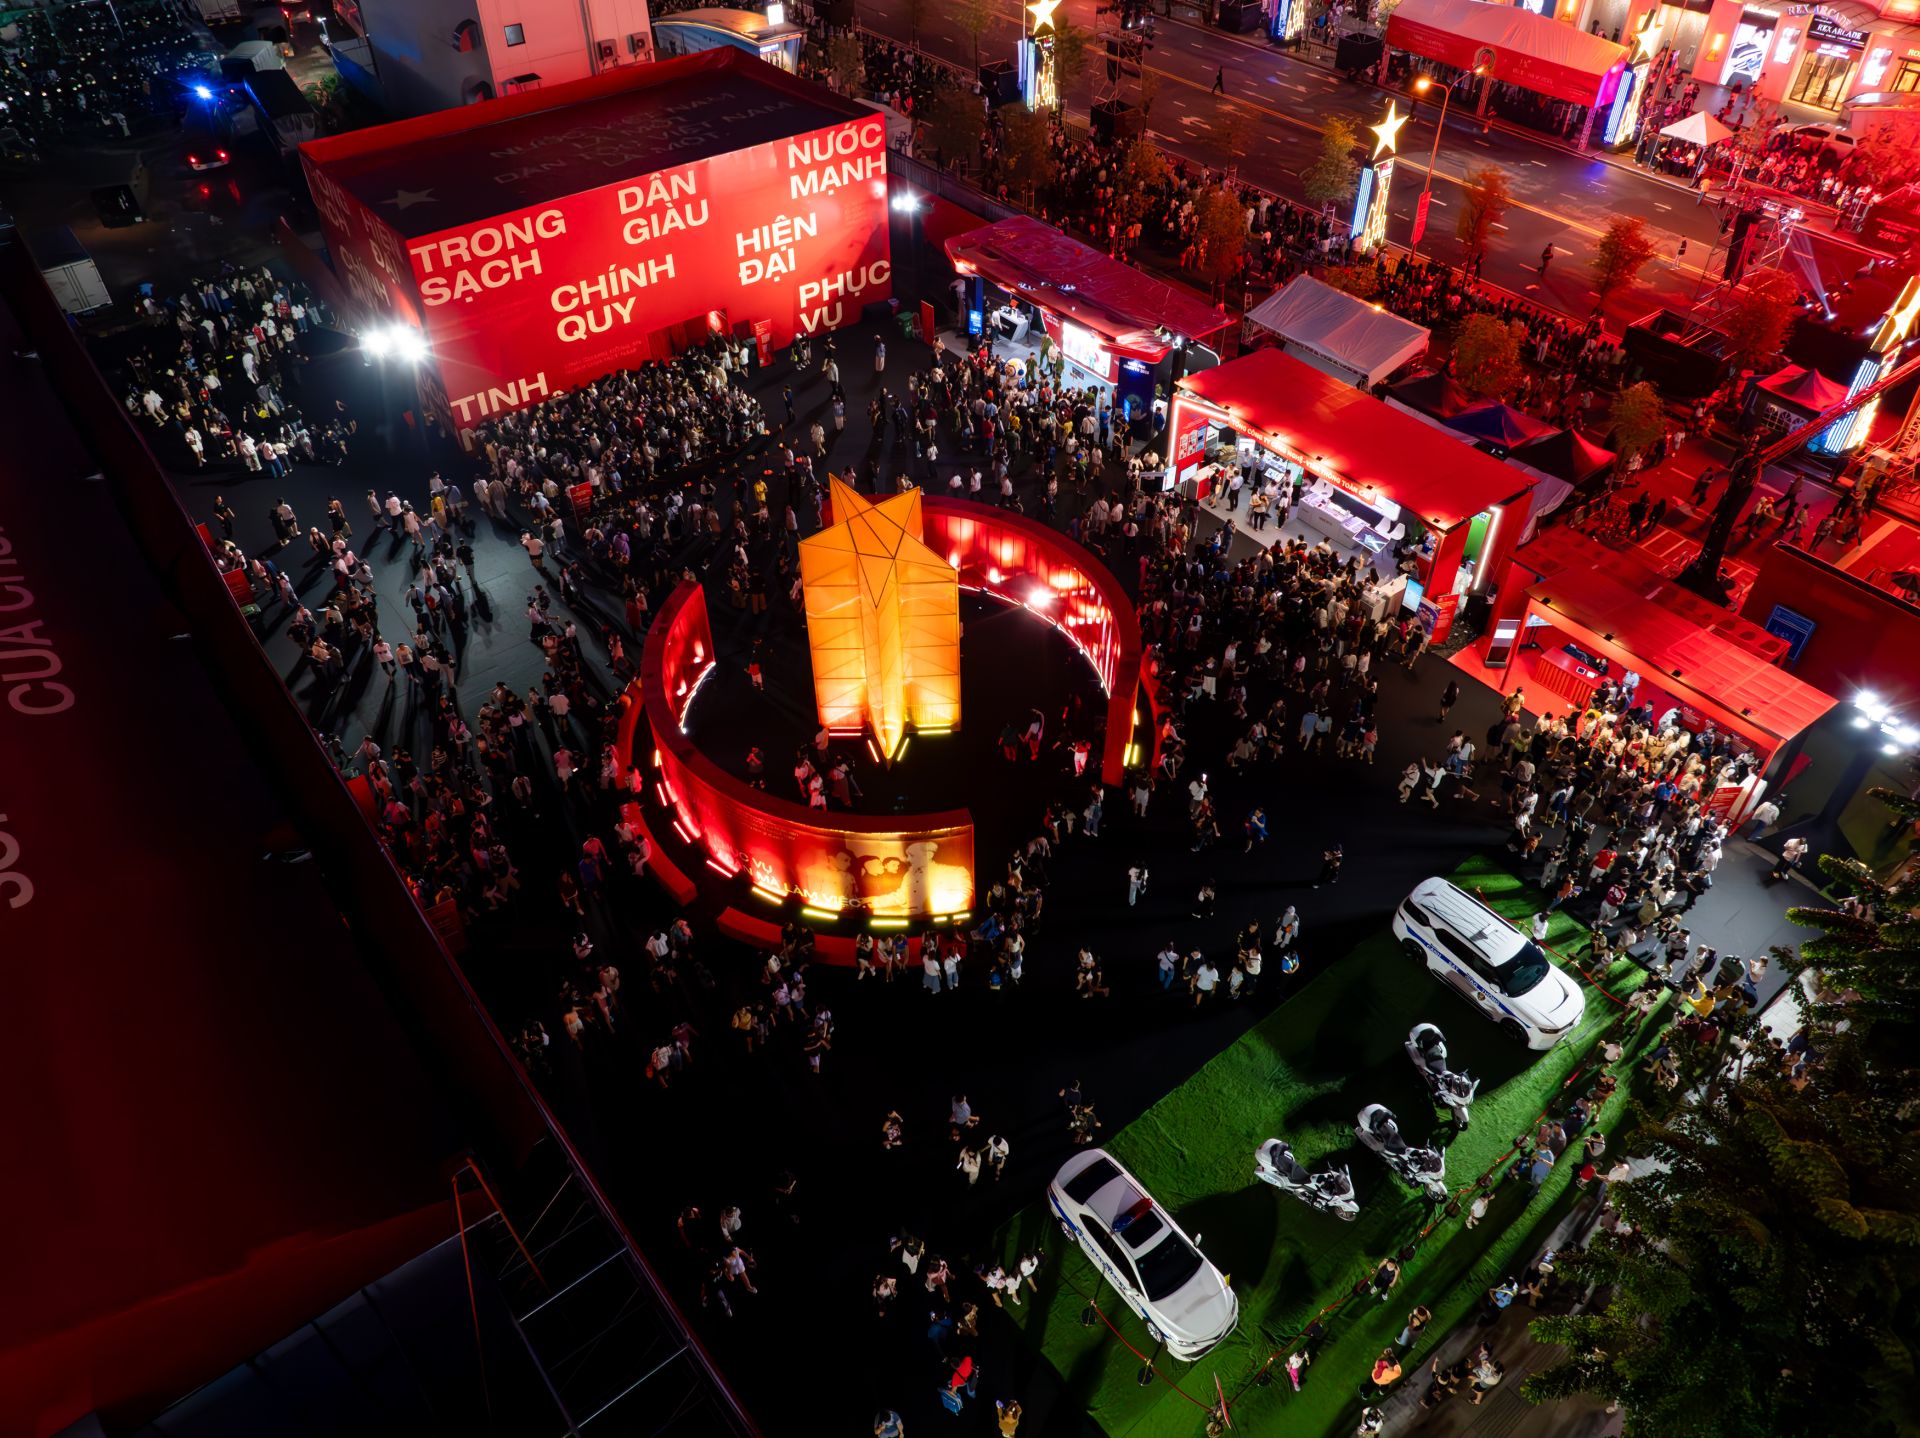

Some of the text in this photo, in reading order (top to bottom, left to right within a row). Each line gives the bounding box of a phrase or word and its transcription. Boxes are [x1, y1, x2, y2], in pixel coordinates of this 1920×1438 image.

[1817, 24, 1832, 34] REX
[1832, 26, 1862, 39] ARCADE
[788, 121, 883, 169] NƯỚC
[618, 168, 697, 215] DÂN
[790, 151, 887, 200] MẠNH
[411, 209, 566, 274] TRONG
[623, 199, 710, 246] GIÀU
[736, 212, 818, 258] HIỆN
[420, 248, 543, 307] SẠCH
[550, 253, 676, 313] CHÍNH
[738, 247, 796, 287] ĐẠI
[799, 259, 891, 309] PHỤC
[556, 296, 637, 343] QUY
[800, 302, 843, 333] VỤ
[450, 371, 549, 423] TINH
